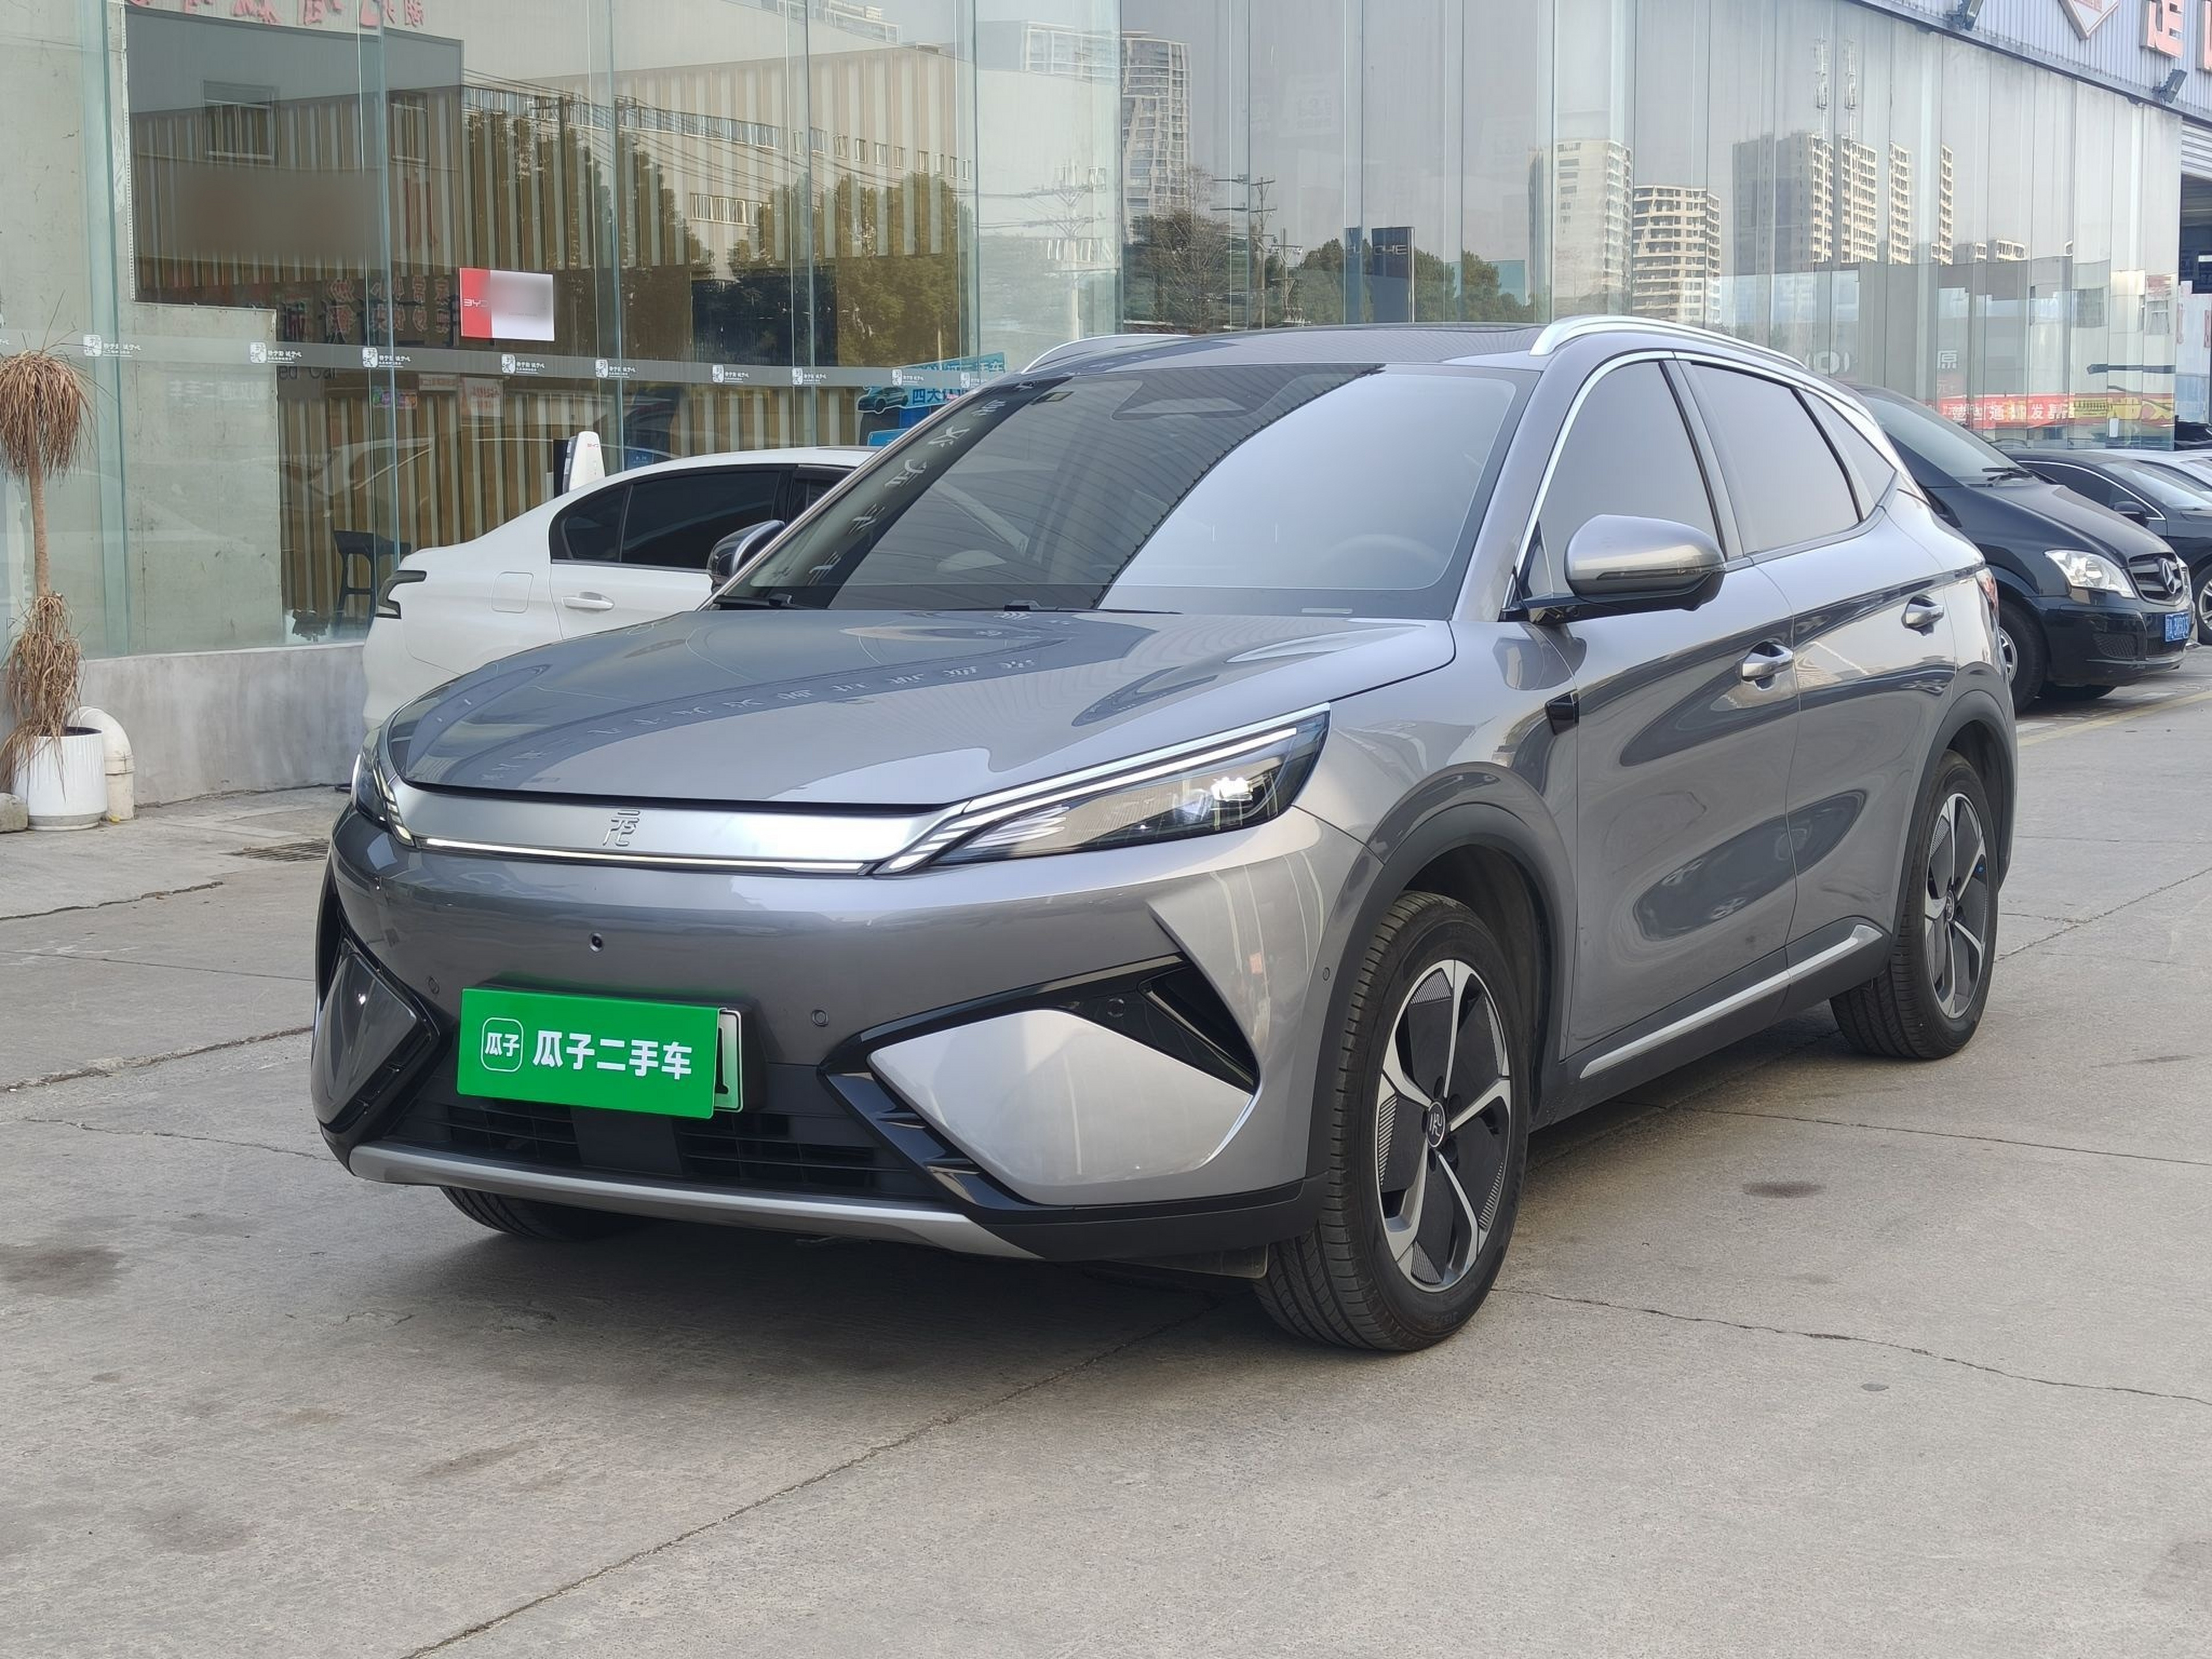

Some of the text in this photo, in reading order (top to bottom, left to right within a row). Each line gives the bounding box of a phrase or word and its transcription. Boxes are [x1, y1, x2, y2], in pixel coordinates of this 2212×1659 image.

[484, 1031, 520, 1058] 瓜子
[533, 1030, 692, 1080] 瓜子二手车
